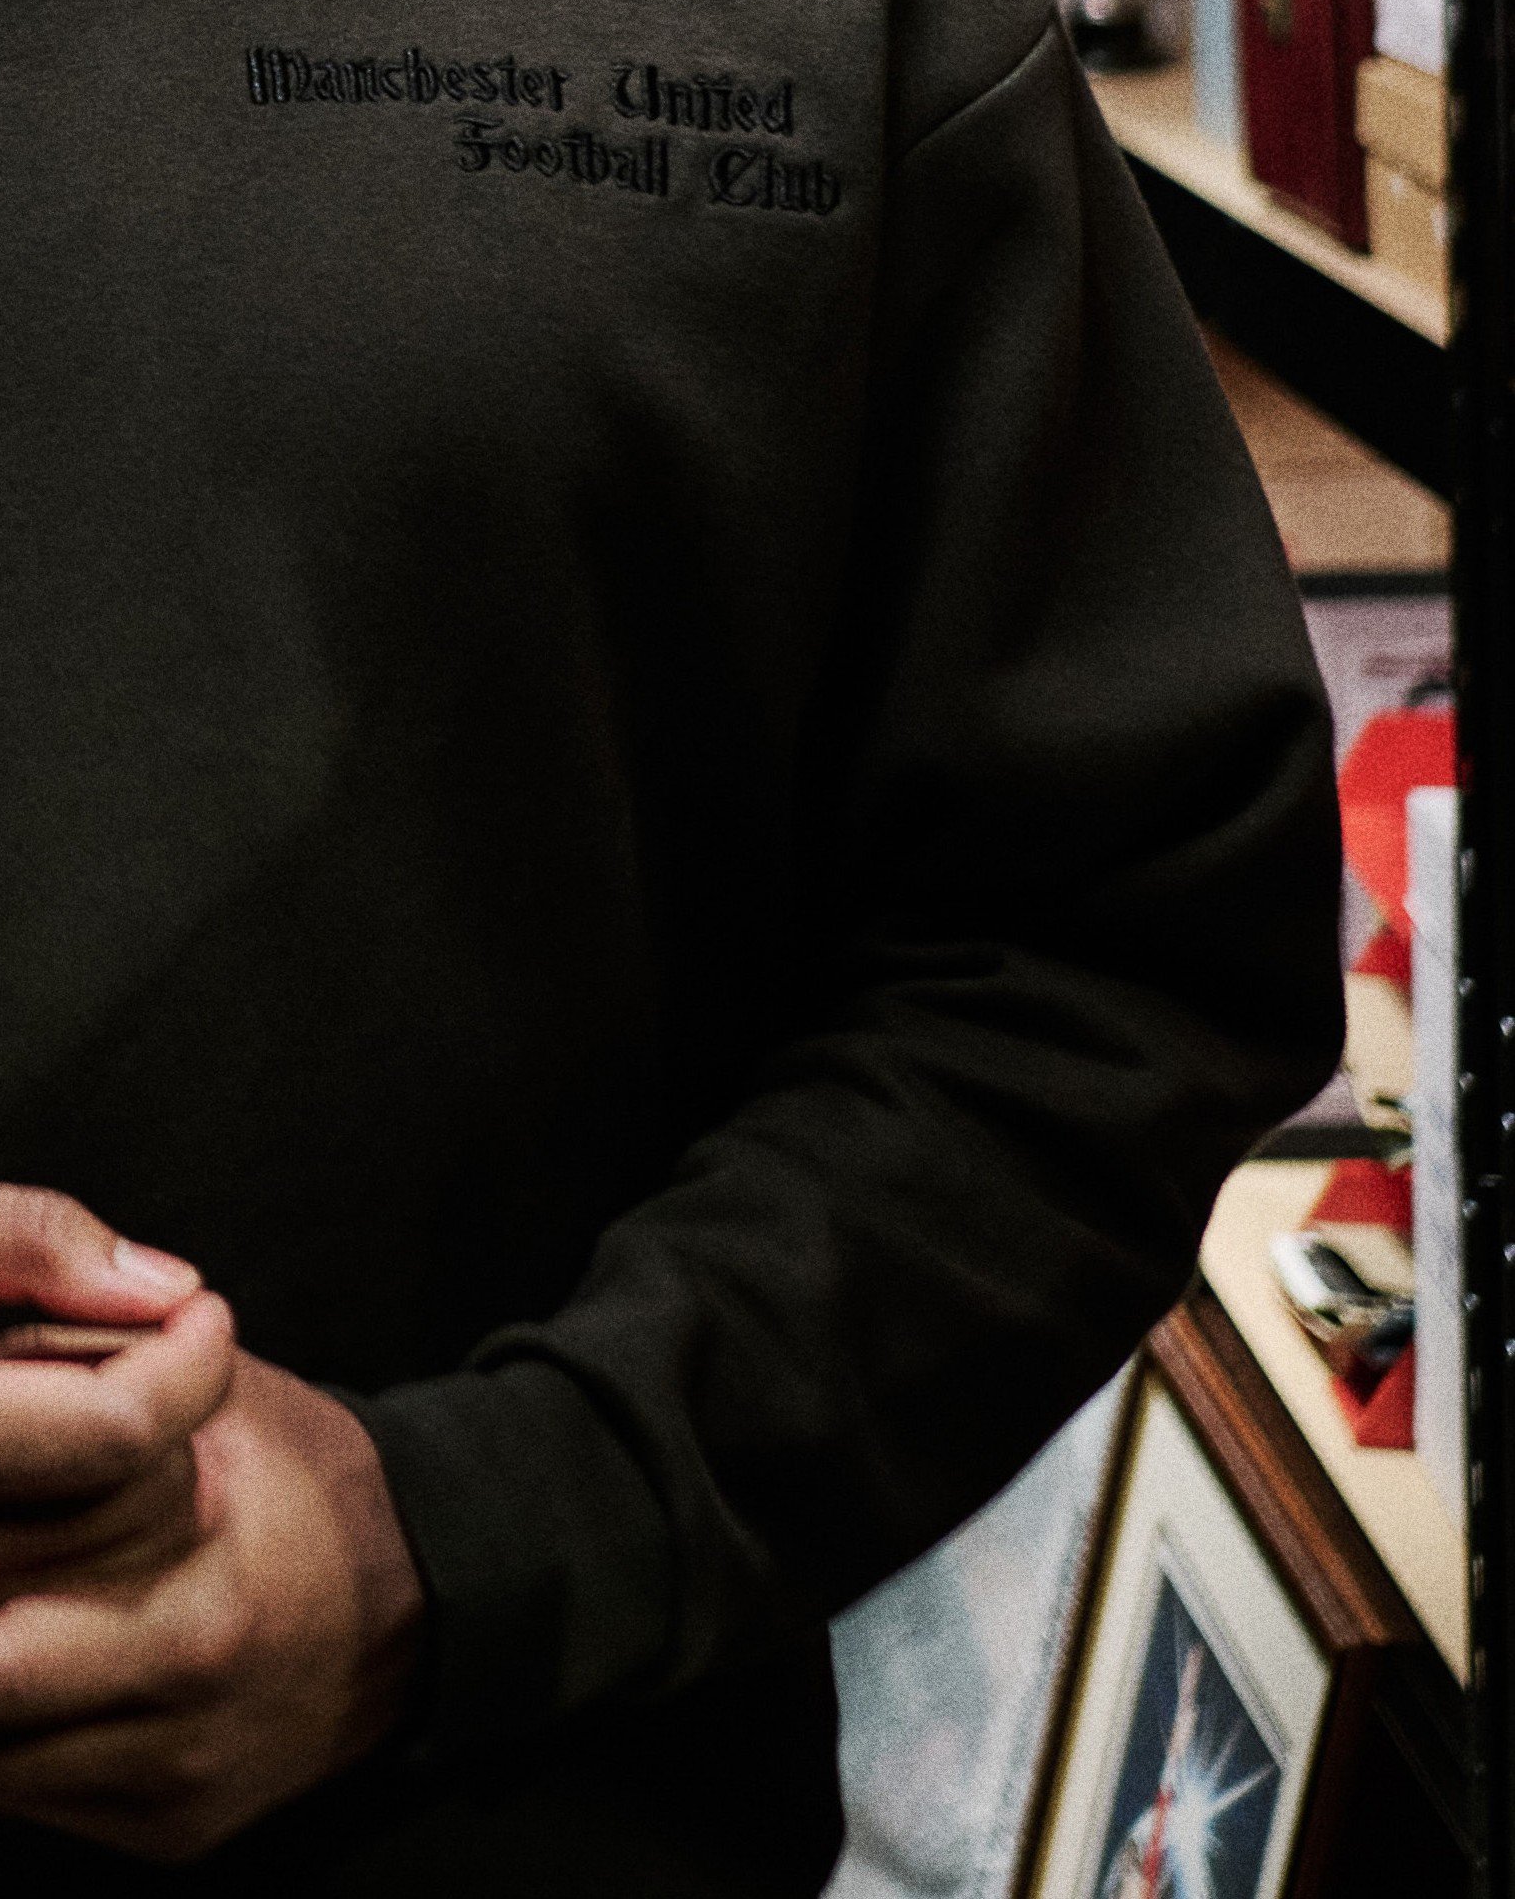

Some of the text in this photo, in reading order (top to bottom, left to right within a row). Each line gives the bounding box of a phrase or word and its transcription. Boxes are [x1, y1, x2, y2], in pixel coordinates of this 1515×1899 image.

[246, 46, 795, 137] Manchester United
[453, 113, 842, 217] Football Club
